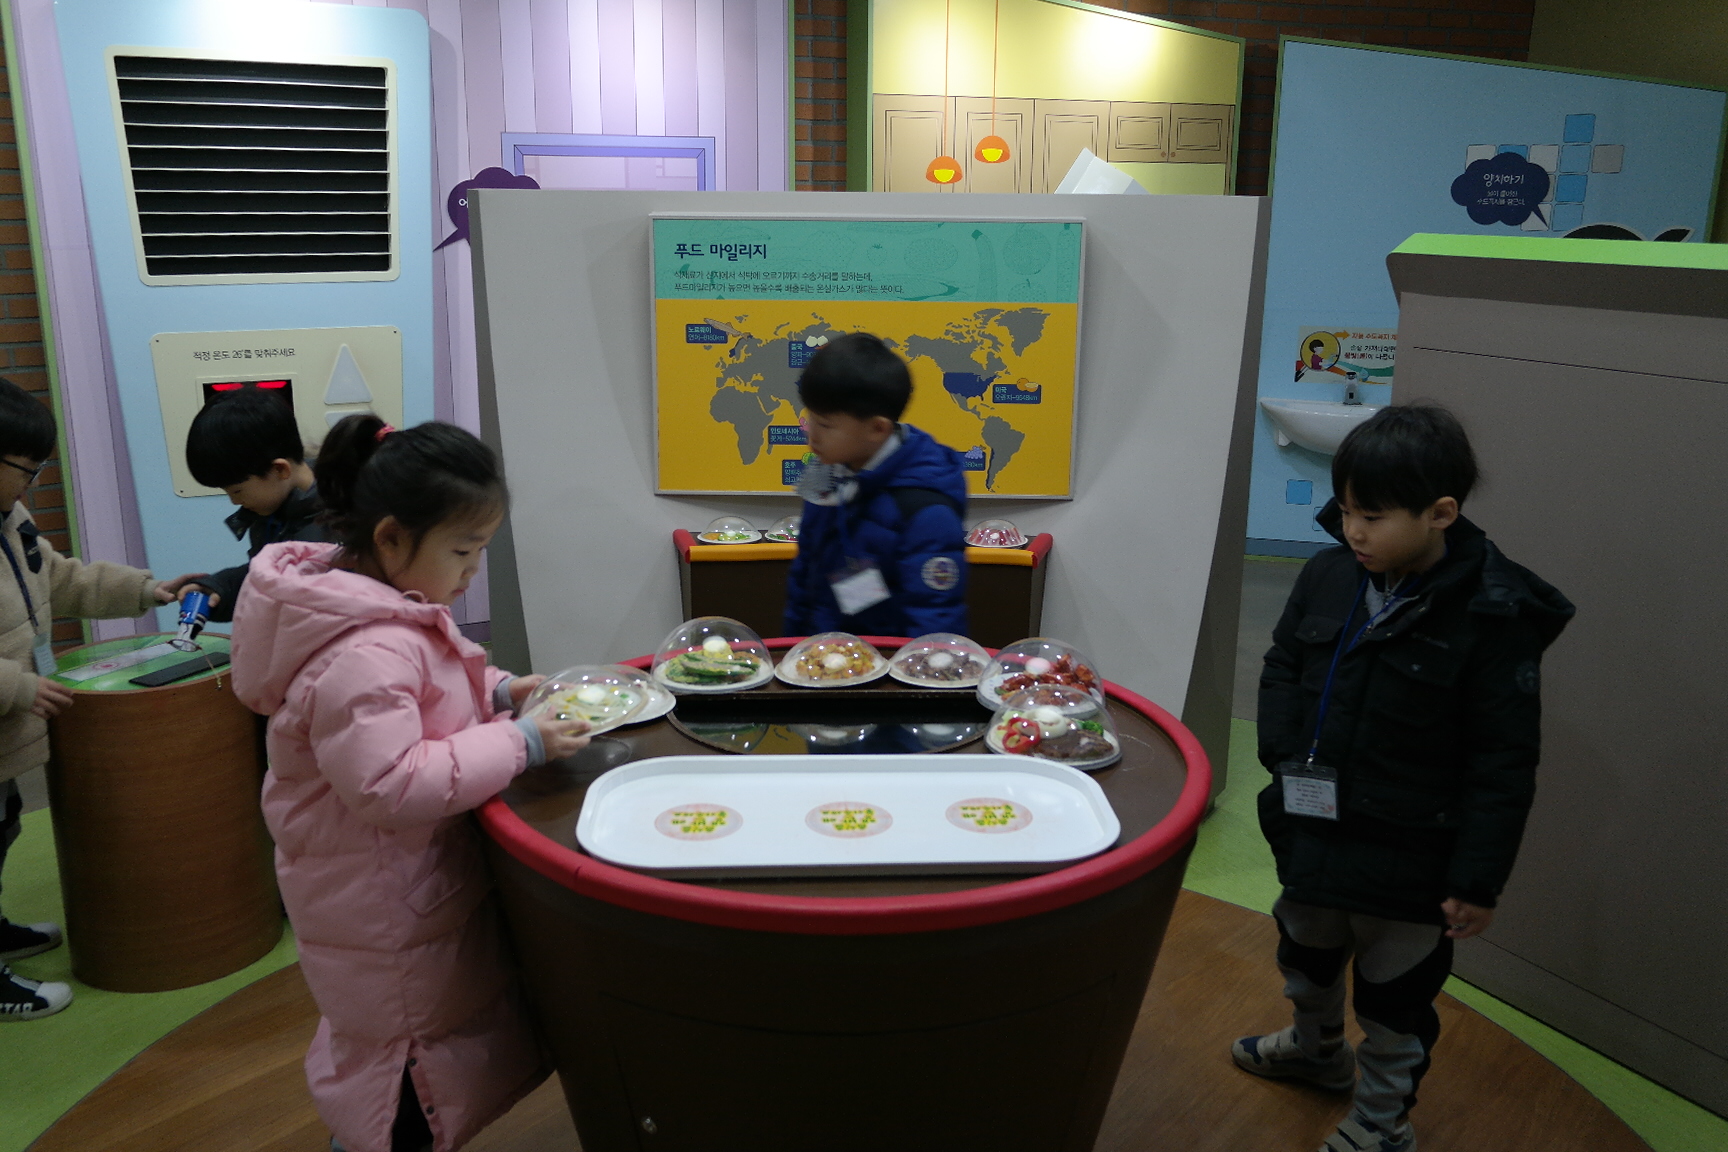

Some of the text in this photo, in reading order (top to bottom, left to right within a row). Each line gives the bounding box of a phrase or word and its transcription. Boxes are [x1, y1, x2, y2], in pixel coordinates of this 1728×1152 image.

[1483, 173, 1524, 187] 양치하기
[674, 243, 767, 262] 푸드 마일리지
[674, 271, 873, 282] 식재료가 산지에서 식탁에 오르기까지 수송거리를 말하는데,
[674, 283, 726, 292] 푸드마일리지가
[728, 283, 751, 292] 높으면
[784, 284, 815, 293] 배출되는
[816, 284, 854, 294] 온실가스가
[855, 284, 879, 294] 많다는
[880, 284, 905, 294] 뜻이다.
[688, 326, 712, 334] 노르웨이
[193, 350, 211, 361] 적정
[212, 350, 231, 361] 온도
[254, 347, 296, 359] 맞춰주세요
[995, 386, 1007, 394] 미국
[770, 427, 800, 435] 인도네시아
[784, 461, 797, 469] 호주
